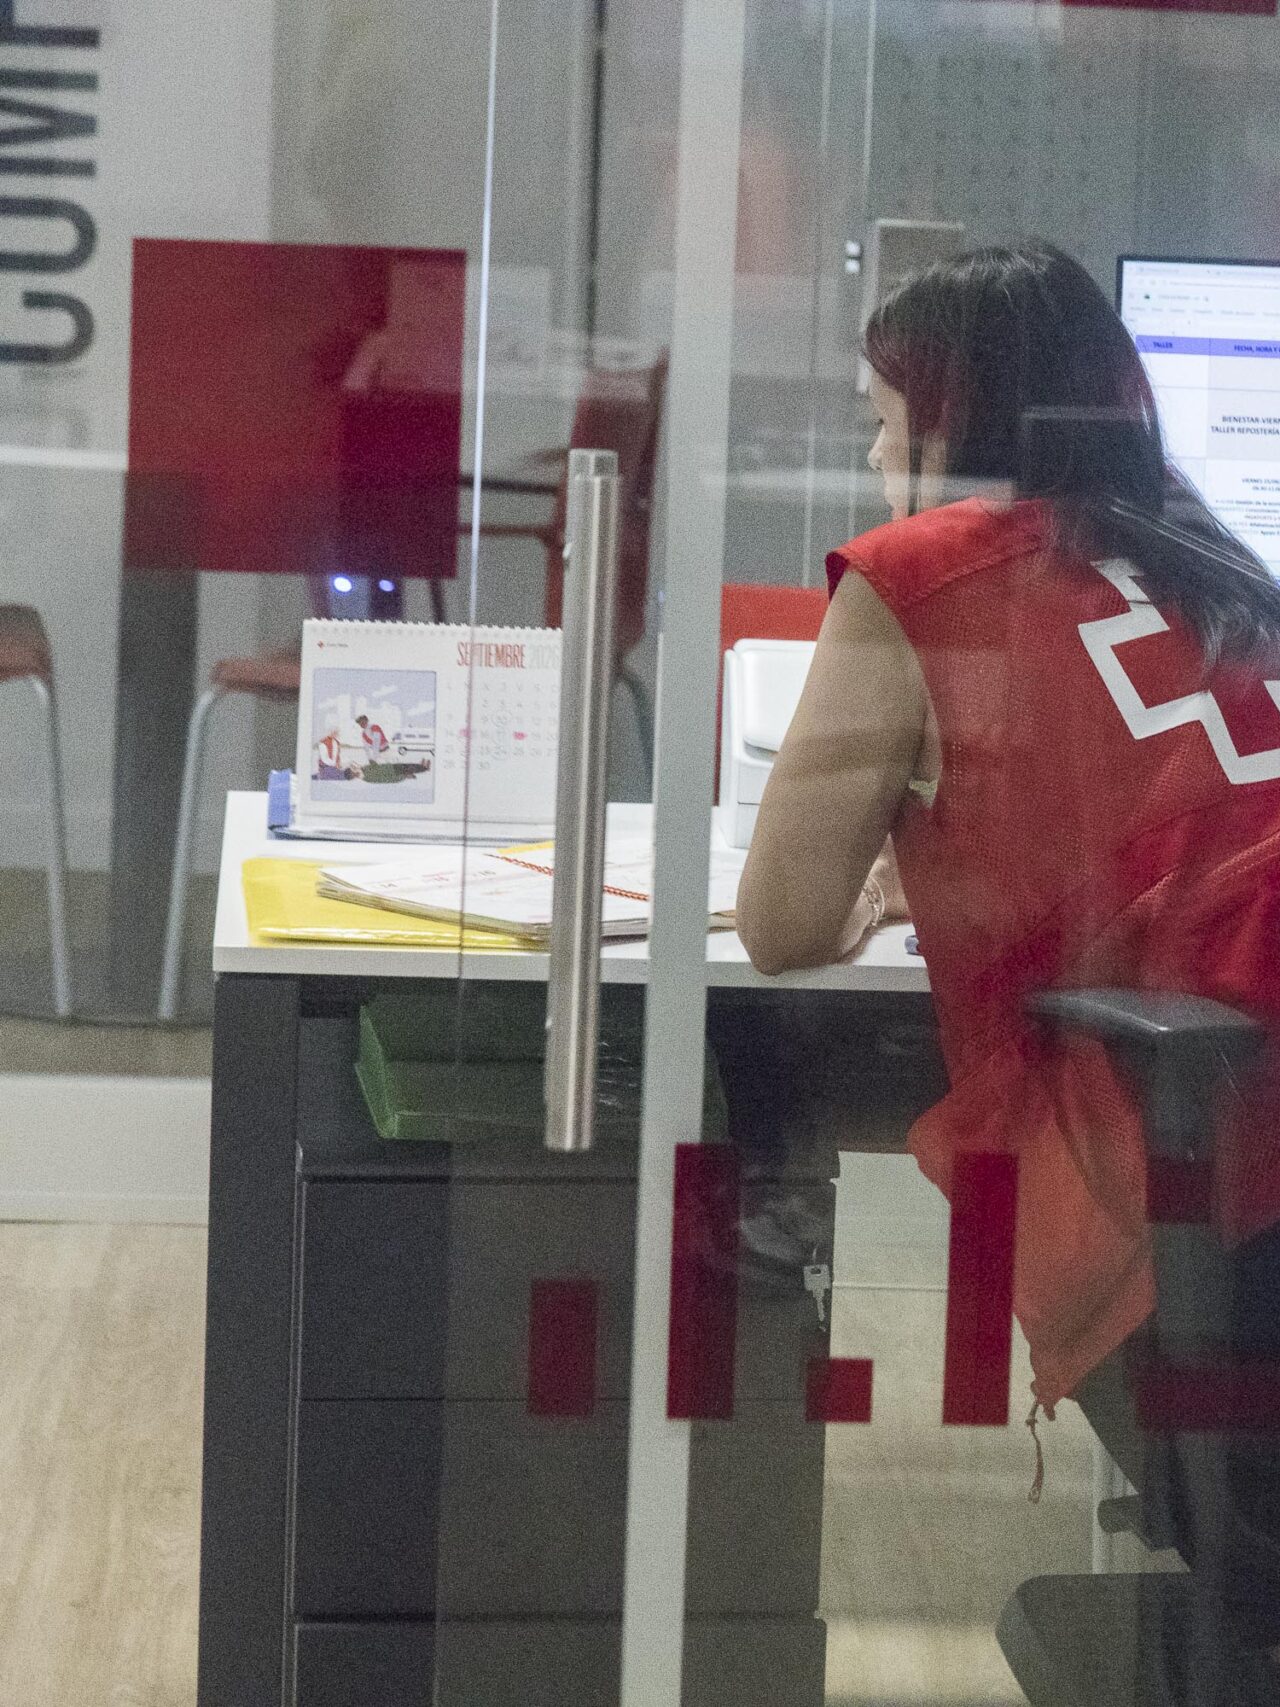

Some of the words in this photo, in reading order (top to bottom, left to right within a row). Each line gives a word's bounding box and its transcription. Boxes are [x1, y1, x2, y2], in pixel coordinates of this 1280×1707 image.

[1153, 341, 1173, 349] TALLER
[1210, 426, 1236, 434] TALLER
[1237, 426, 1280, 436] REPOSTERÍA
[456, 641, 527, 669] SEPTIEMBRE
